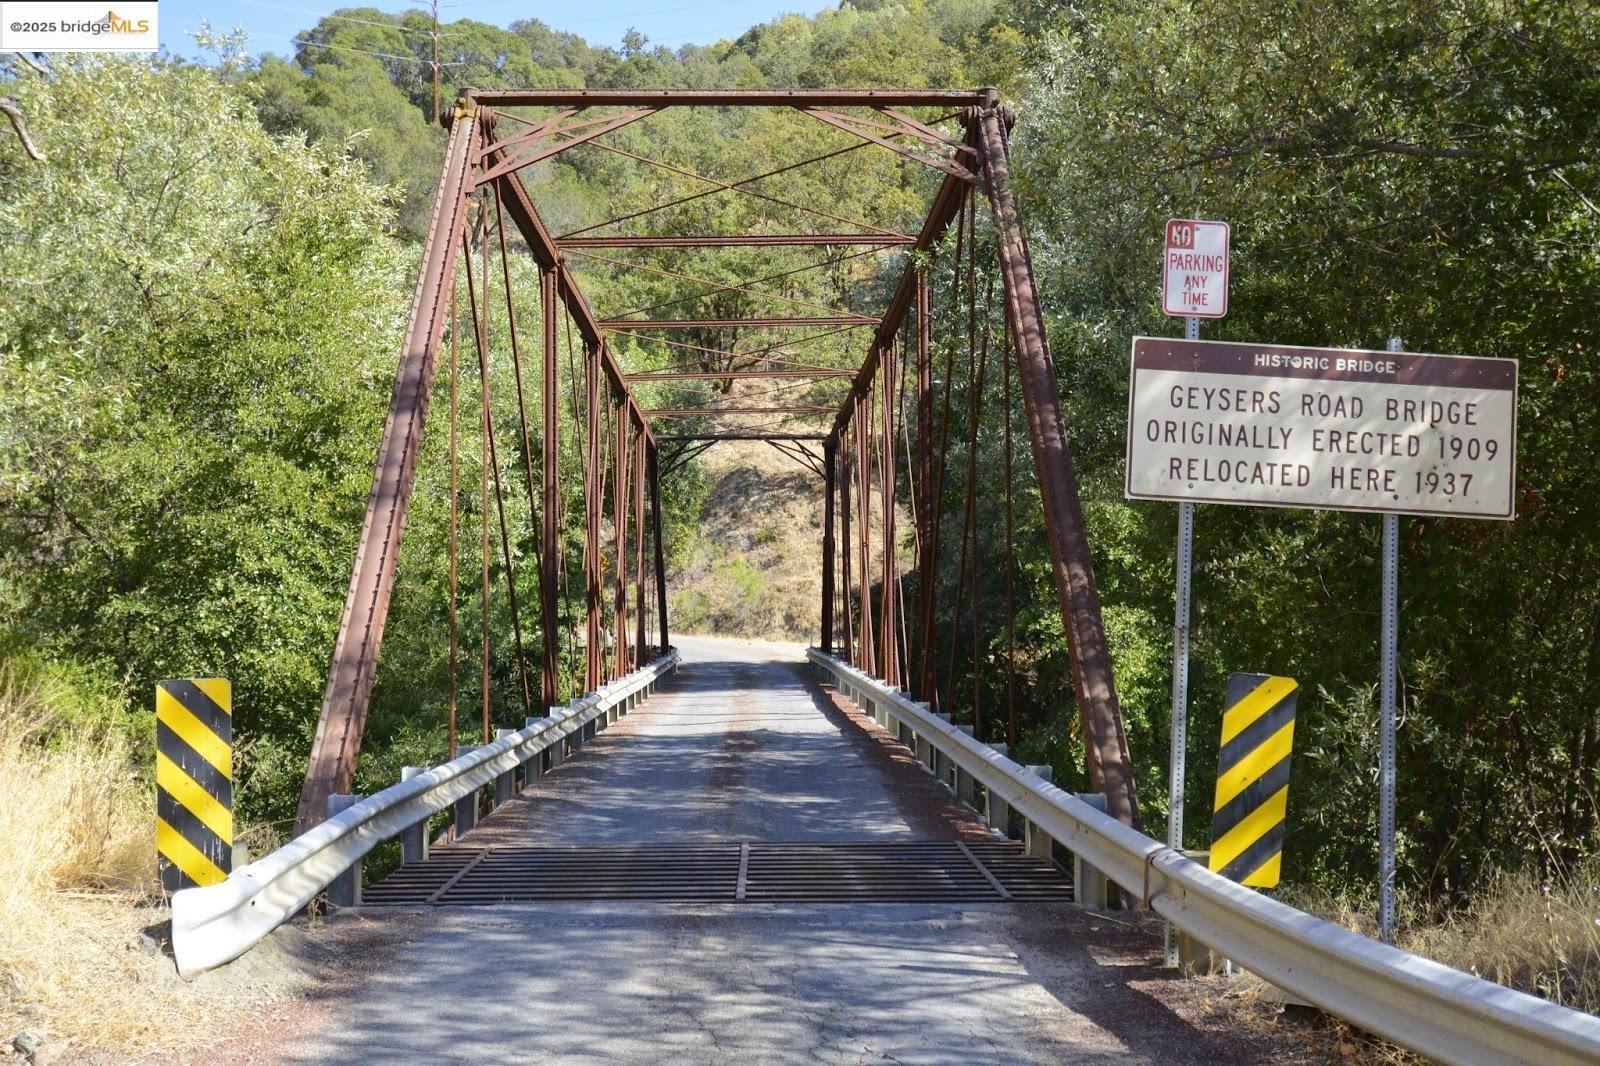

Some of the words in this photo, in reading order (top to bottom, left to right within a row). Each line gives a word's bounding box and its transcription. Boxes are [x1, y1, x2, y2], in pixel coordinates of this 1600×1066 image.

[1172, 226, 1191, 246] NO
[1170, 253, 1223, 272] PARKING
[1184, 275, 1207, 288] ANY
[1182, 292, 1208, 305] TIME
[1253, 354, 1329, 371] HISTORIC
[1336, 358, 1396, 374] BRIDGE
[1170, 385, 1281, 414] GEYSERS
[1301, 394, 1363, 419] ROAD
[1386, 398, 1477, 426] BRIDGE
[1146, 419, 1293, 450] ORIGINALLY
[1312, 429, 1420, 457] ERECTED
[1439, 436, 1499, 462] 1909
[1169, 457, 1310, 487] RELOCATED
[1331, 467, 1396, 492] HERE
[1415, 471, 1473, 497] 1937
